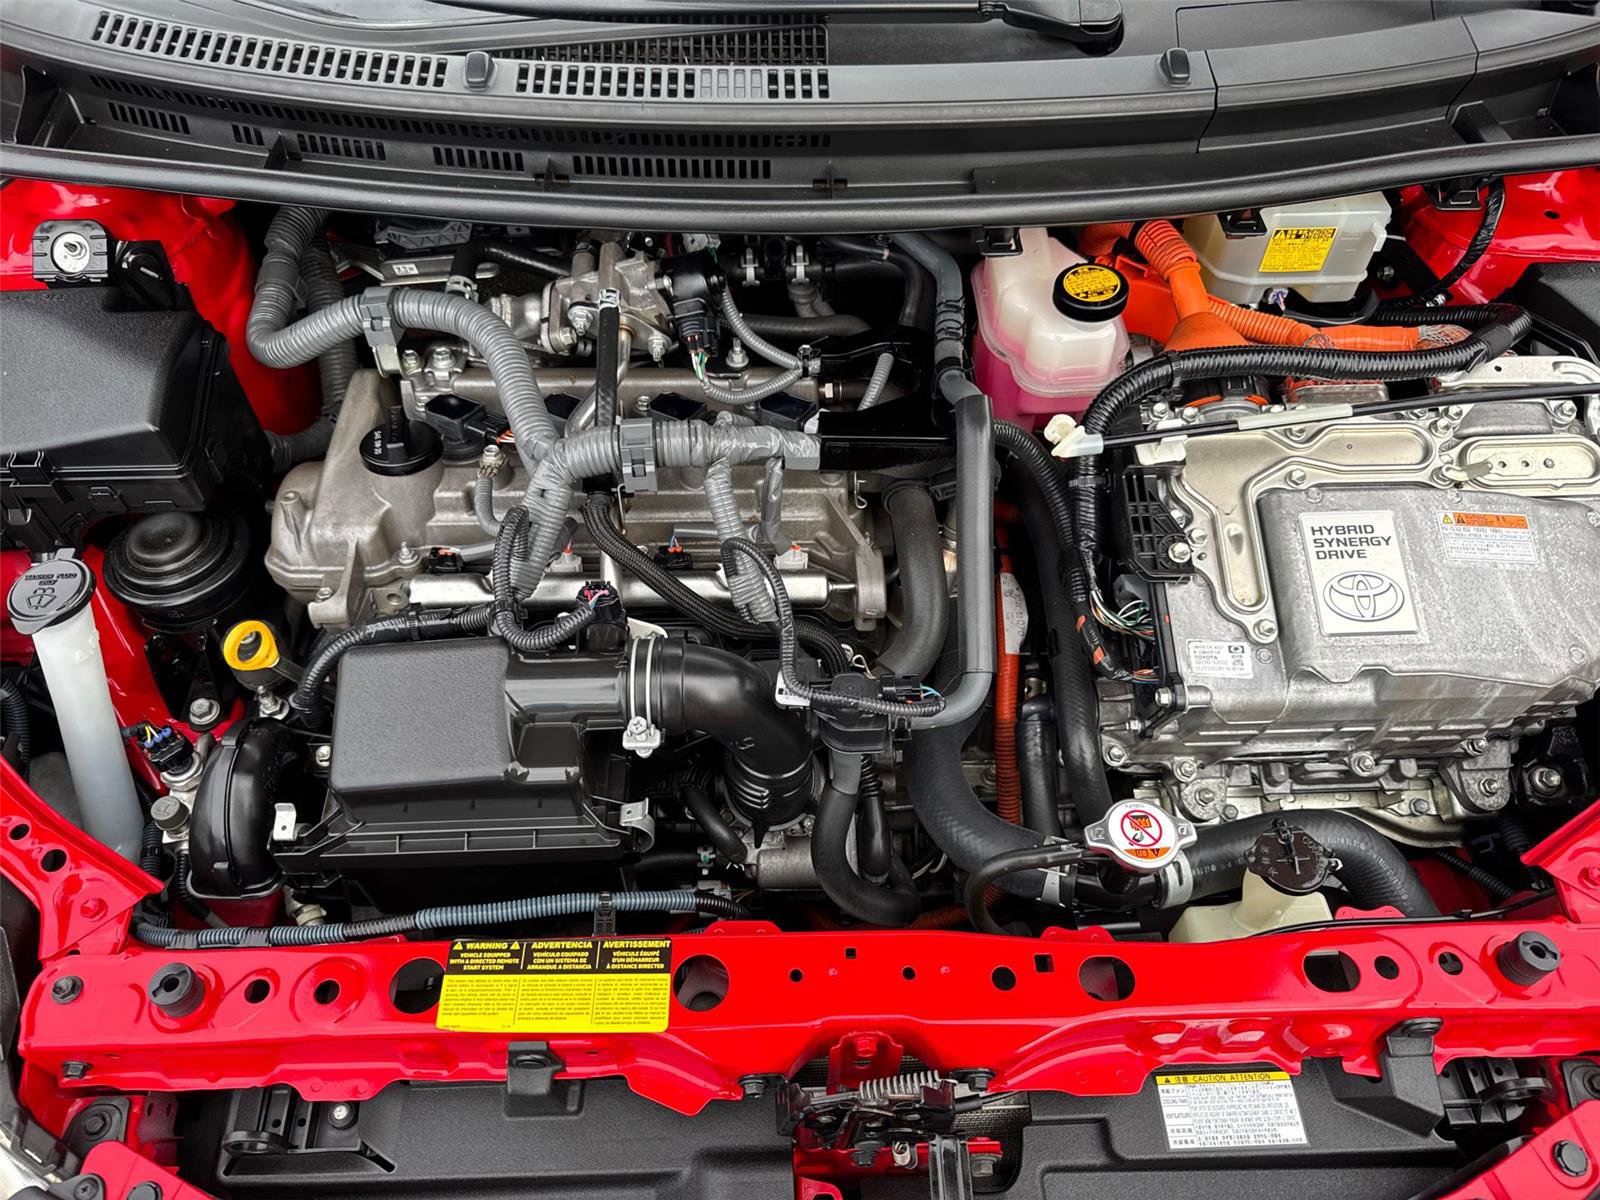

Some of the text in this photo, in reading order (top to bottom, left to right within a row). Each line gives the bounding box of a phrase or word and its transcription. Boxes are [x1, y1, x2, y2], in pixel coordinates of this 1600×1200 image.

[1310, 524, 1375, 536] HYBRID
[1313, 536, 1392, 548] SYNERGY
[1315, 549, 1367, 560] DRIVE
[466, 942, 508, 950] WARNING
[531, 941, 593, 949] ADVERTENCIA
[602, 940, 671, 948] AVERTISSEMENT
[1192, 1073, 1271, 1083] CAUTION ATTENTION
